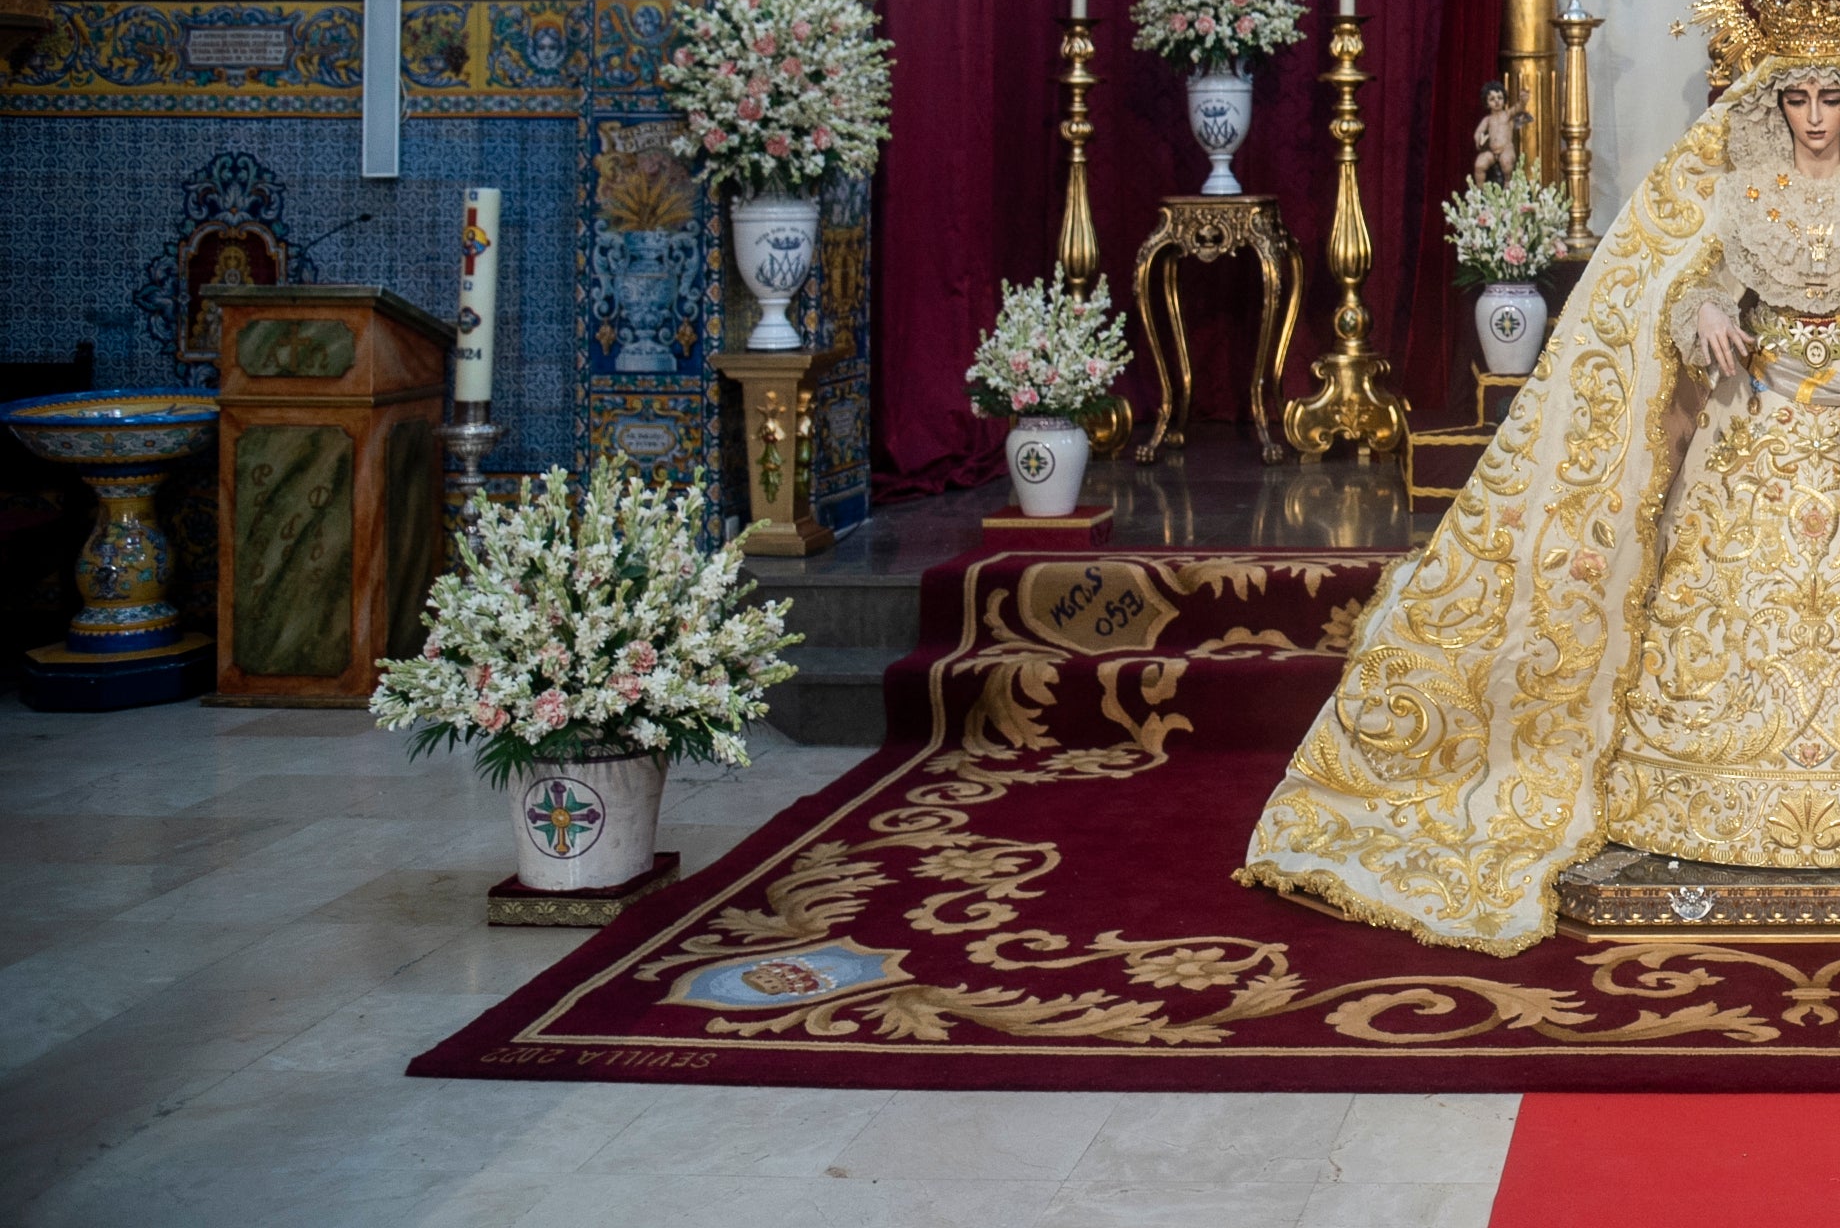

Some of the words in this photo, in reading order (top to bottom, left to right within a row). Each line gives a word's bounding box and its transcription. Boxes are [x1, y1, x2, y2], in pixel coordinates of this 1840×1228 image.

[1050, 567, 1103, 627] SUM
[1095, 590, 1144, 636] EGO
[479, 1046, 565, 1064] 2022
[575, 1050, 718, 1069] SEVILLA
